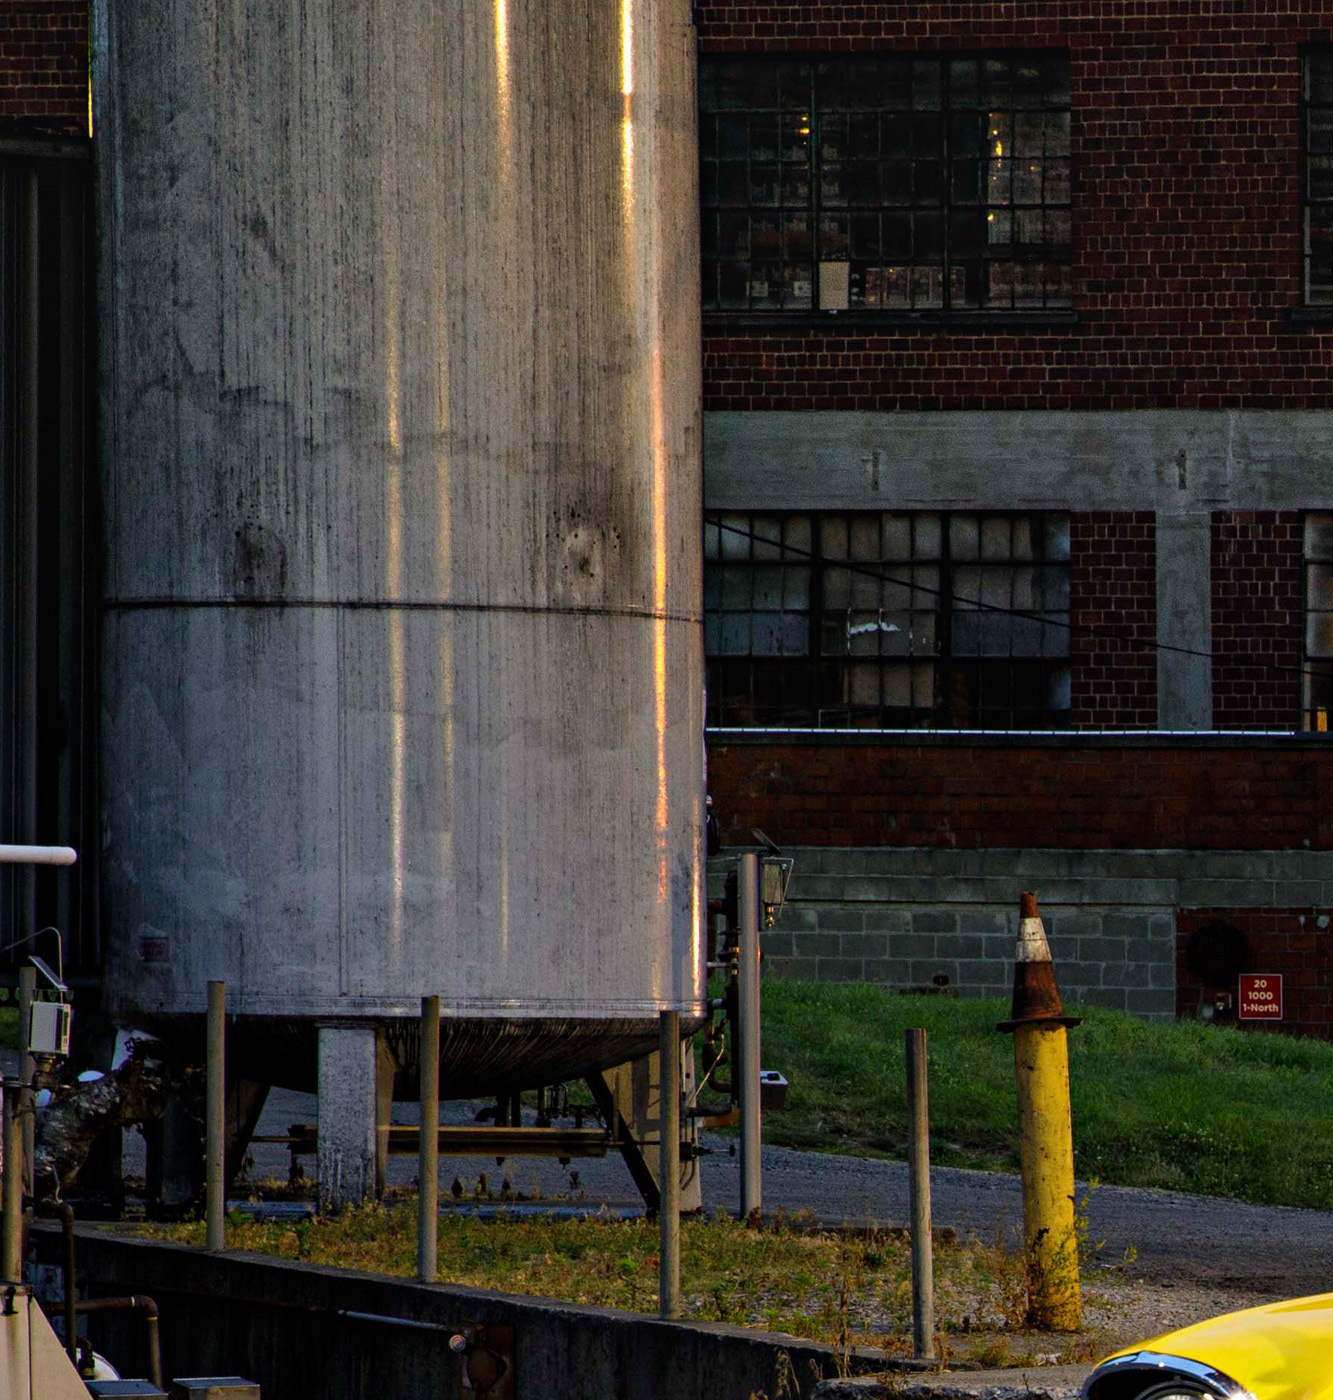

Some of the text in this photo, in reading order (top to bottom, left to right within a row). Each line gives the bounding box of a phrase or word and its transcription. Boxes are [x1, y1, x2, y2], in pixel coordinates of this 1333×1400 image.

[1254, 980, 1267, 988] 20
[1248, 991, 1273, 1000] 1000
[1242, 1003, 1279, 1012] 1-North
